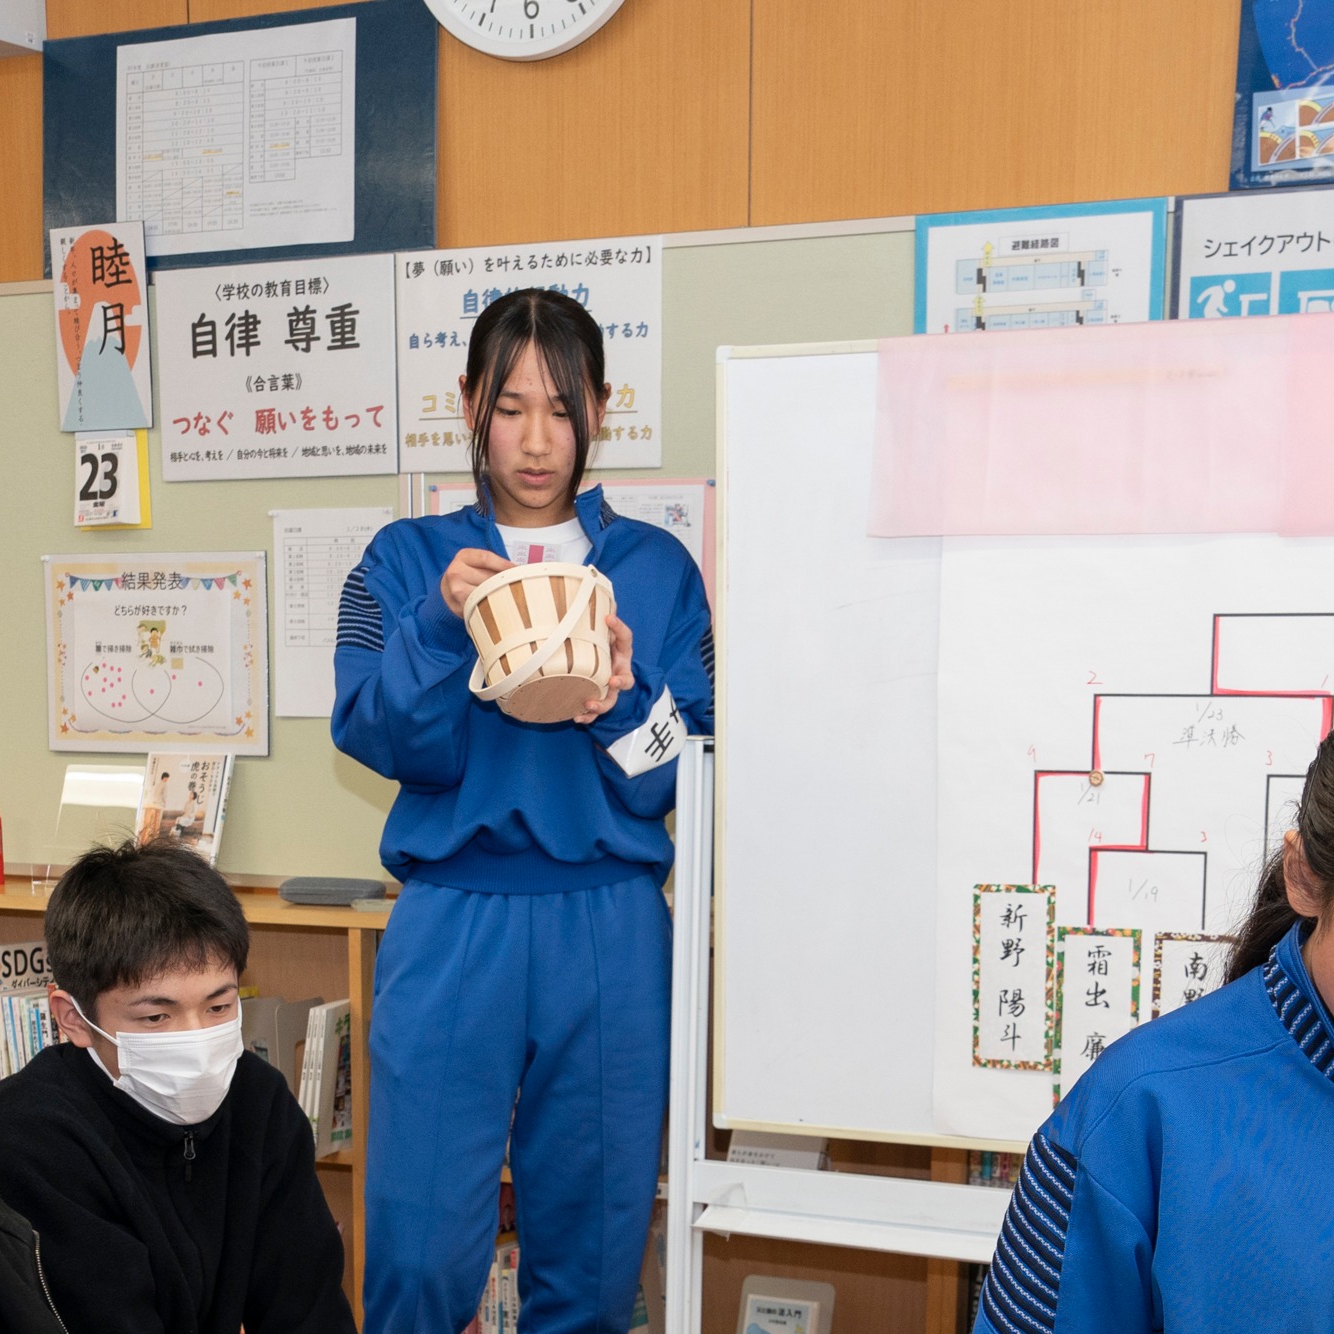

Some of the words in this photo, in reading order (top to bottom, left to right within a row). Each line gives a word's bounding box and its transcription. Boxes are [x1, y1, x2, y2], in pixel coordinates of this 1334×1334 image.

[524, 0, 539, 19] 6
[1011, 238, 1060, 251] 避難経路図
[90, 236, 133, 357] 睦月
[191, 310, 261, 359] 自律
[284, 303, 360, 353] 尊重
[598, 321, 649, 340] する力
[616, 384, 636, 408] 力
[173, 410, 234, 436] つなぐ
[255, 404, 385, 435] 願いをもって
[79, 452, 119, 501] 23
[122, 571, 183, 591] 結果発表
[1086, 669, 1103, 685] 2
[1173, 723, 1246, 749] 準決勝
[188, 761, 201, 792] 虎の巻
[197, 761, 210, 805] おそうじ
[1000, 903, 1028, 967] 新野
[1085, 945, 1113, 1009] 霜出
[999, 988, 1026, 1051] 陽斗
